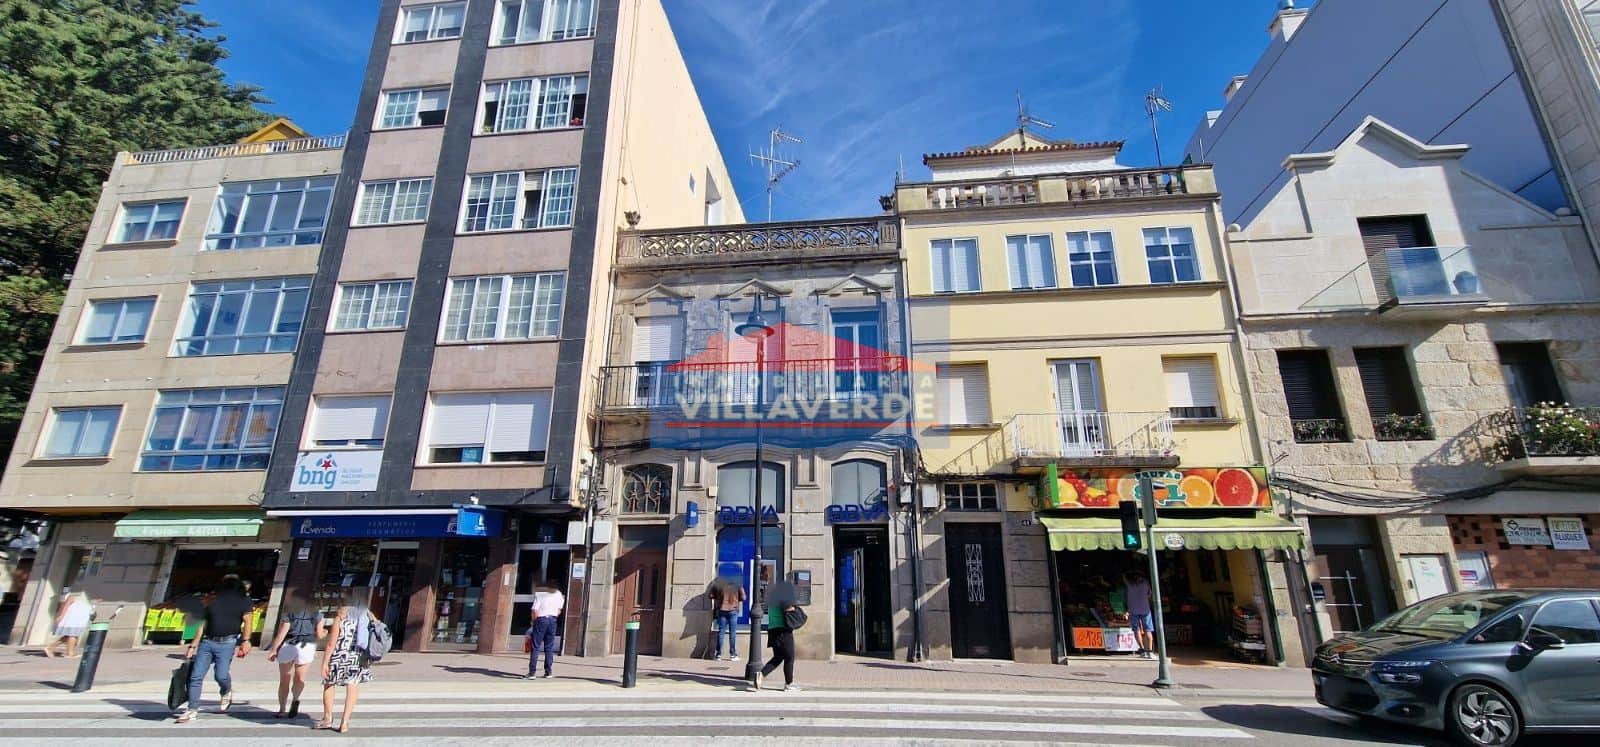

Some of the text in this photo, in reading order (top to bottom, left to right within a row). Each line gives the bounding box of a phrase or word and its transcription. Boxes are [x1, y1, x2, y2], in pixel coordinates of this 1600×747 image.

[298, 465, 337, 489] bng
[720, 504, 779, 524] BBVA
[828, 503, 891, 523] BBVA
